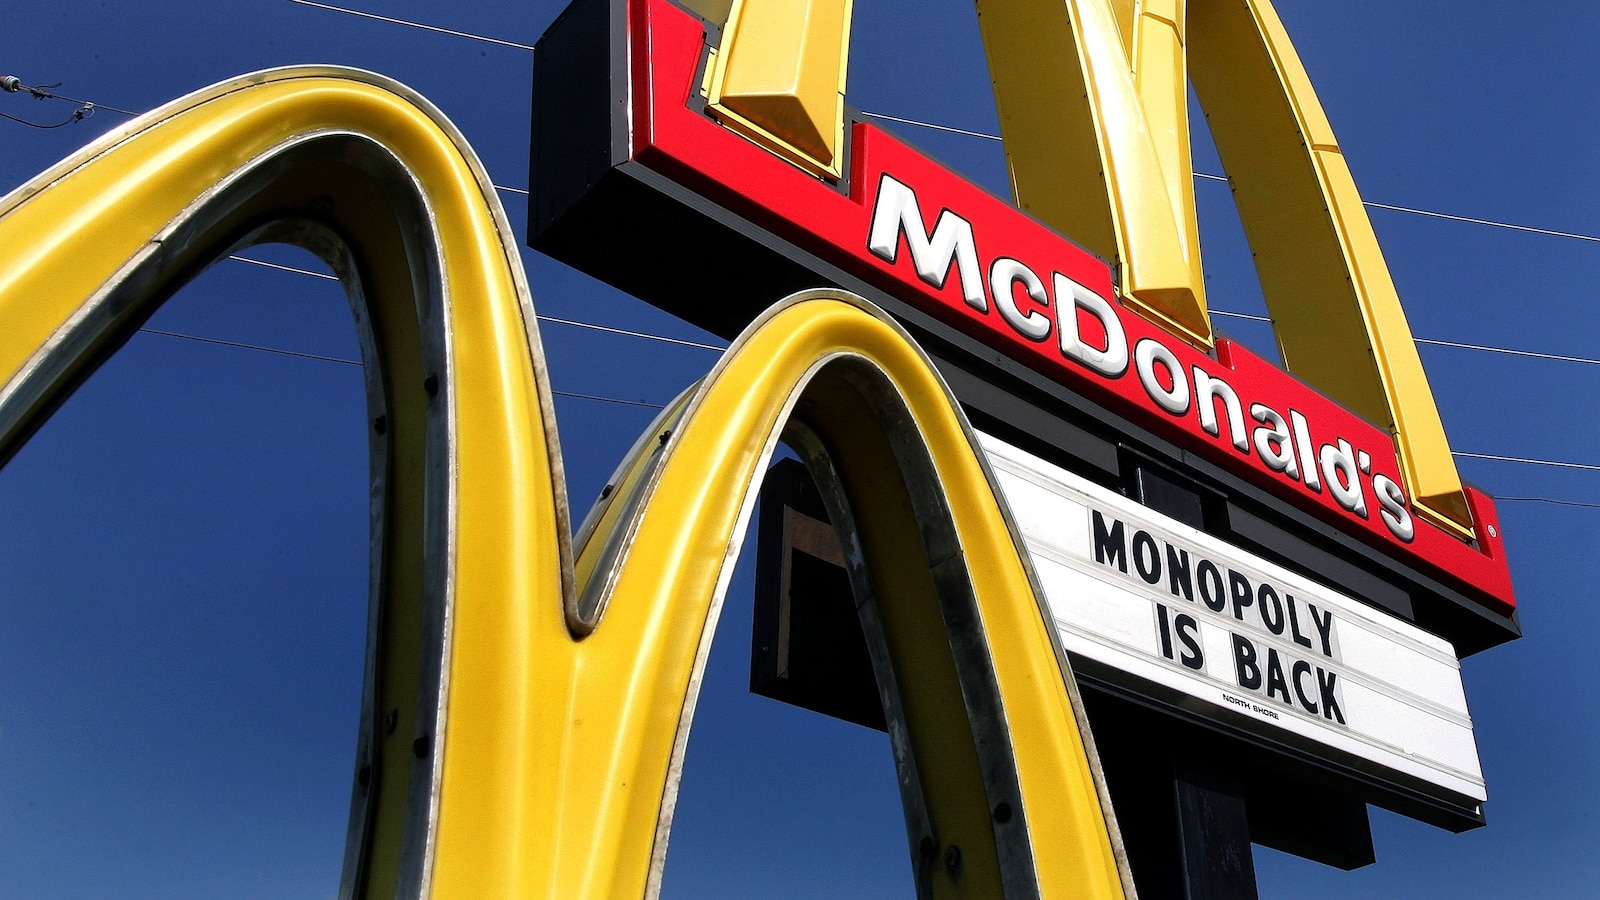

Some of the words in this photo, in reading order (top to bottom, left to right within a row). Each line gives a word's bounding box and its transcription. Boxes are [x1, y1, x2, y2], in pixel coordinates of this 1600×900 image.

[867, 173, 1415, 541] McDonald's
[1092, 510, 1332, 657] MONOPOLY
[1156, 604, 1204, 670] IS
[1233, 633, 1346, 724] BACK
[1222, 693, 1251, 710] NORTH
[1252, 705, 1279, 720] SHORE
